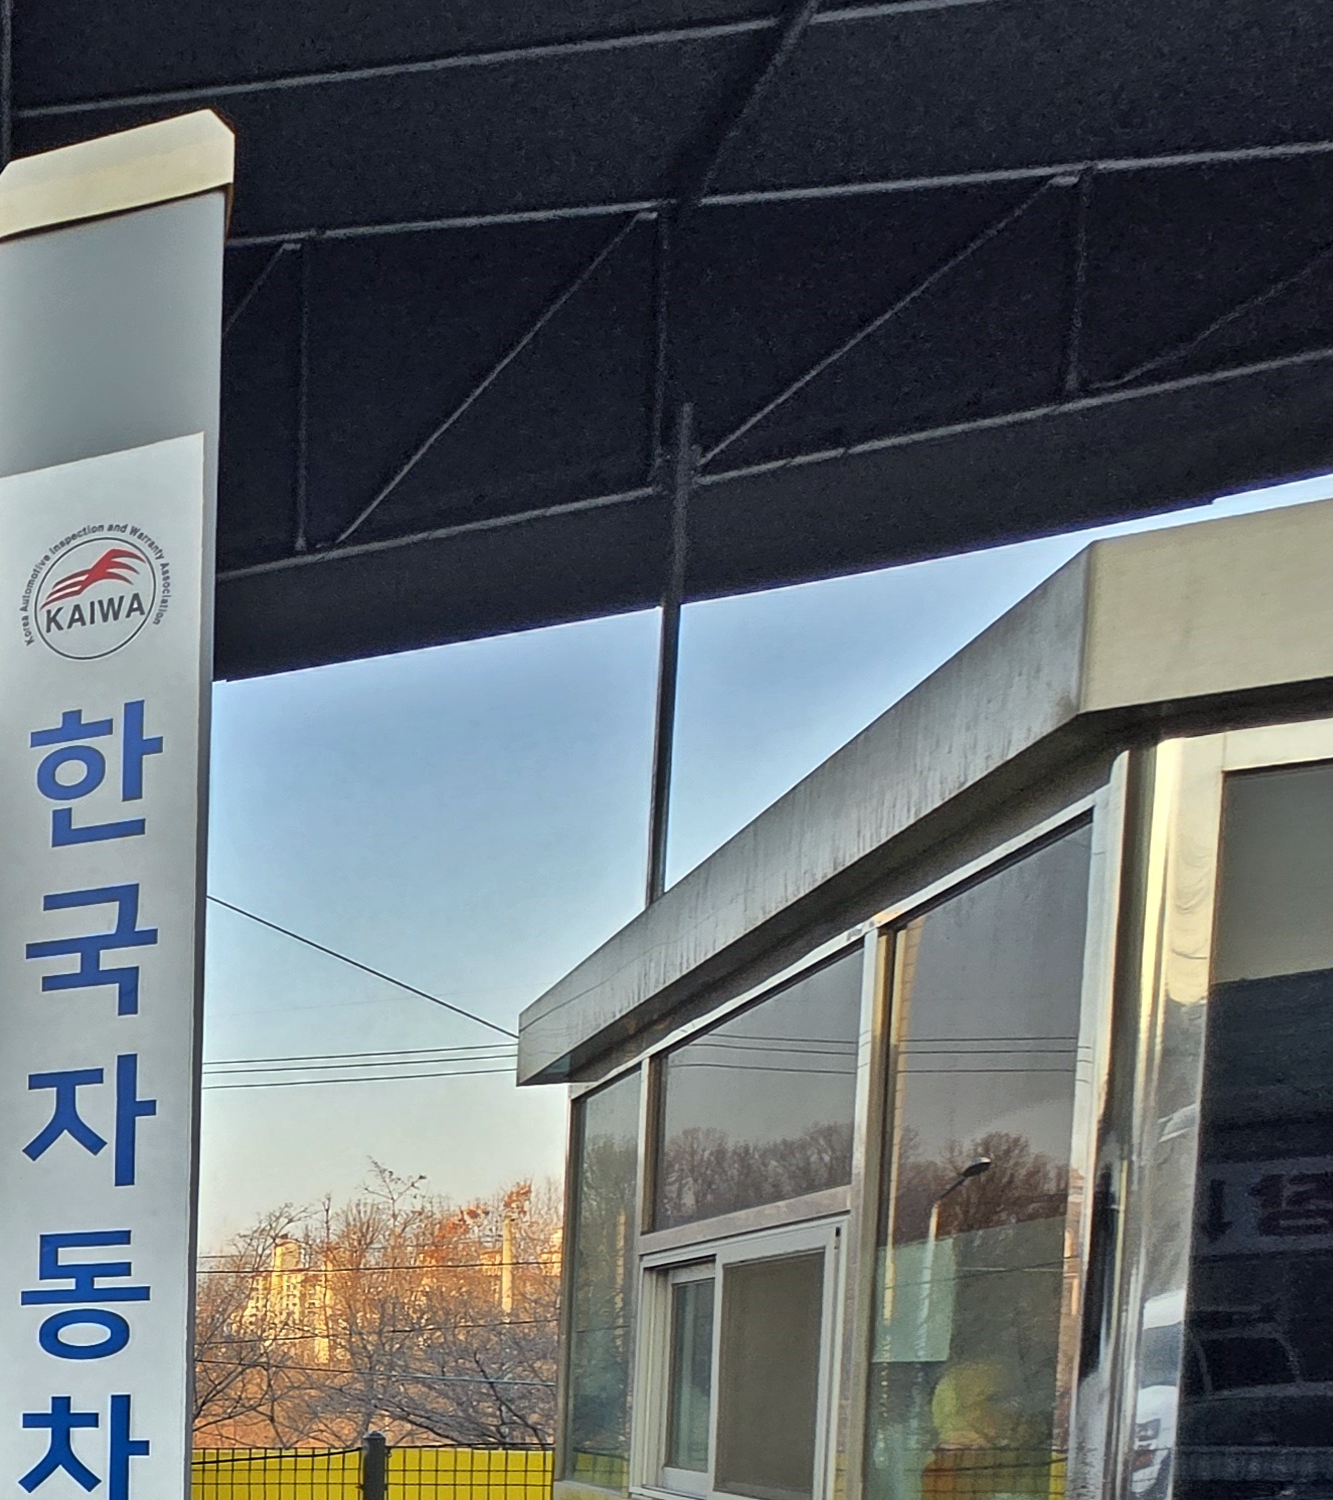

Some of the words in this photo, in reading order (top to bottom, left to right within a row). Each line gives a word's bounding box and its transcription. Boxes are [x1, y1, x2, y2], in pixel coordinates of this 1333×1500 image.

[48, 524, 105, 555] Inspection
[107, 523, 129, 534] and
[129, 525, 165, 560] Warranty
[19, 554, 51, 612] Automotive
[153, 562, 172, 626] Association
[45, 592, 146, 634] KAIWA
[21, 615, 35, 647] Korea
